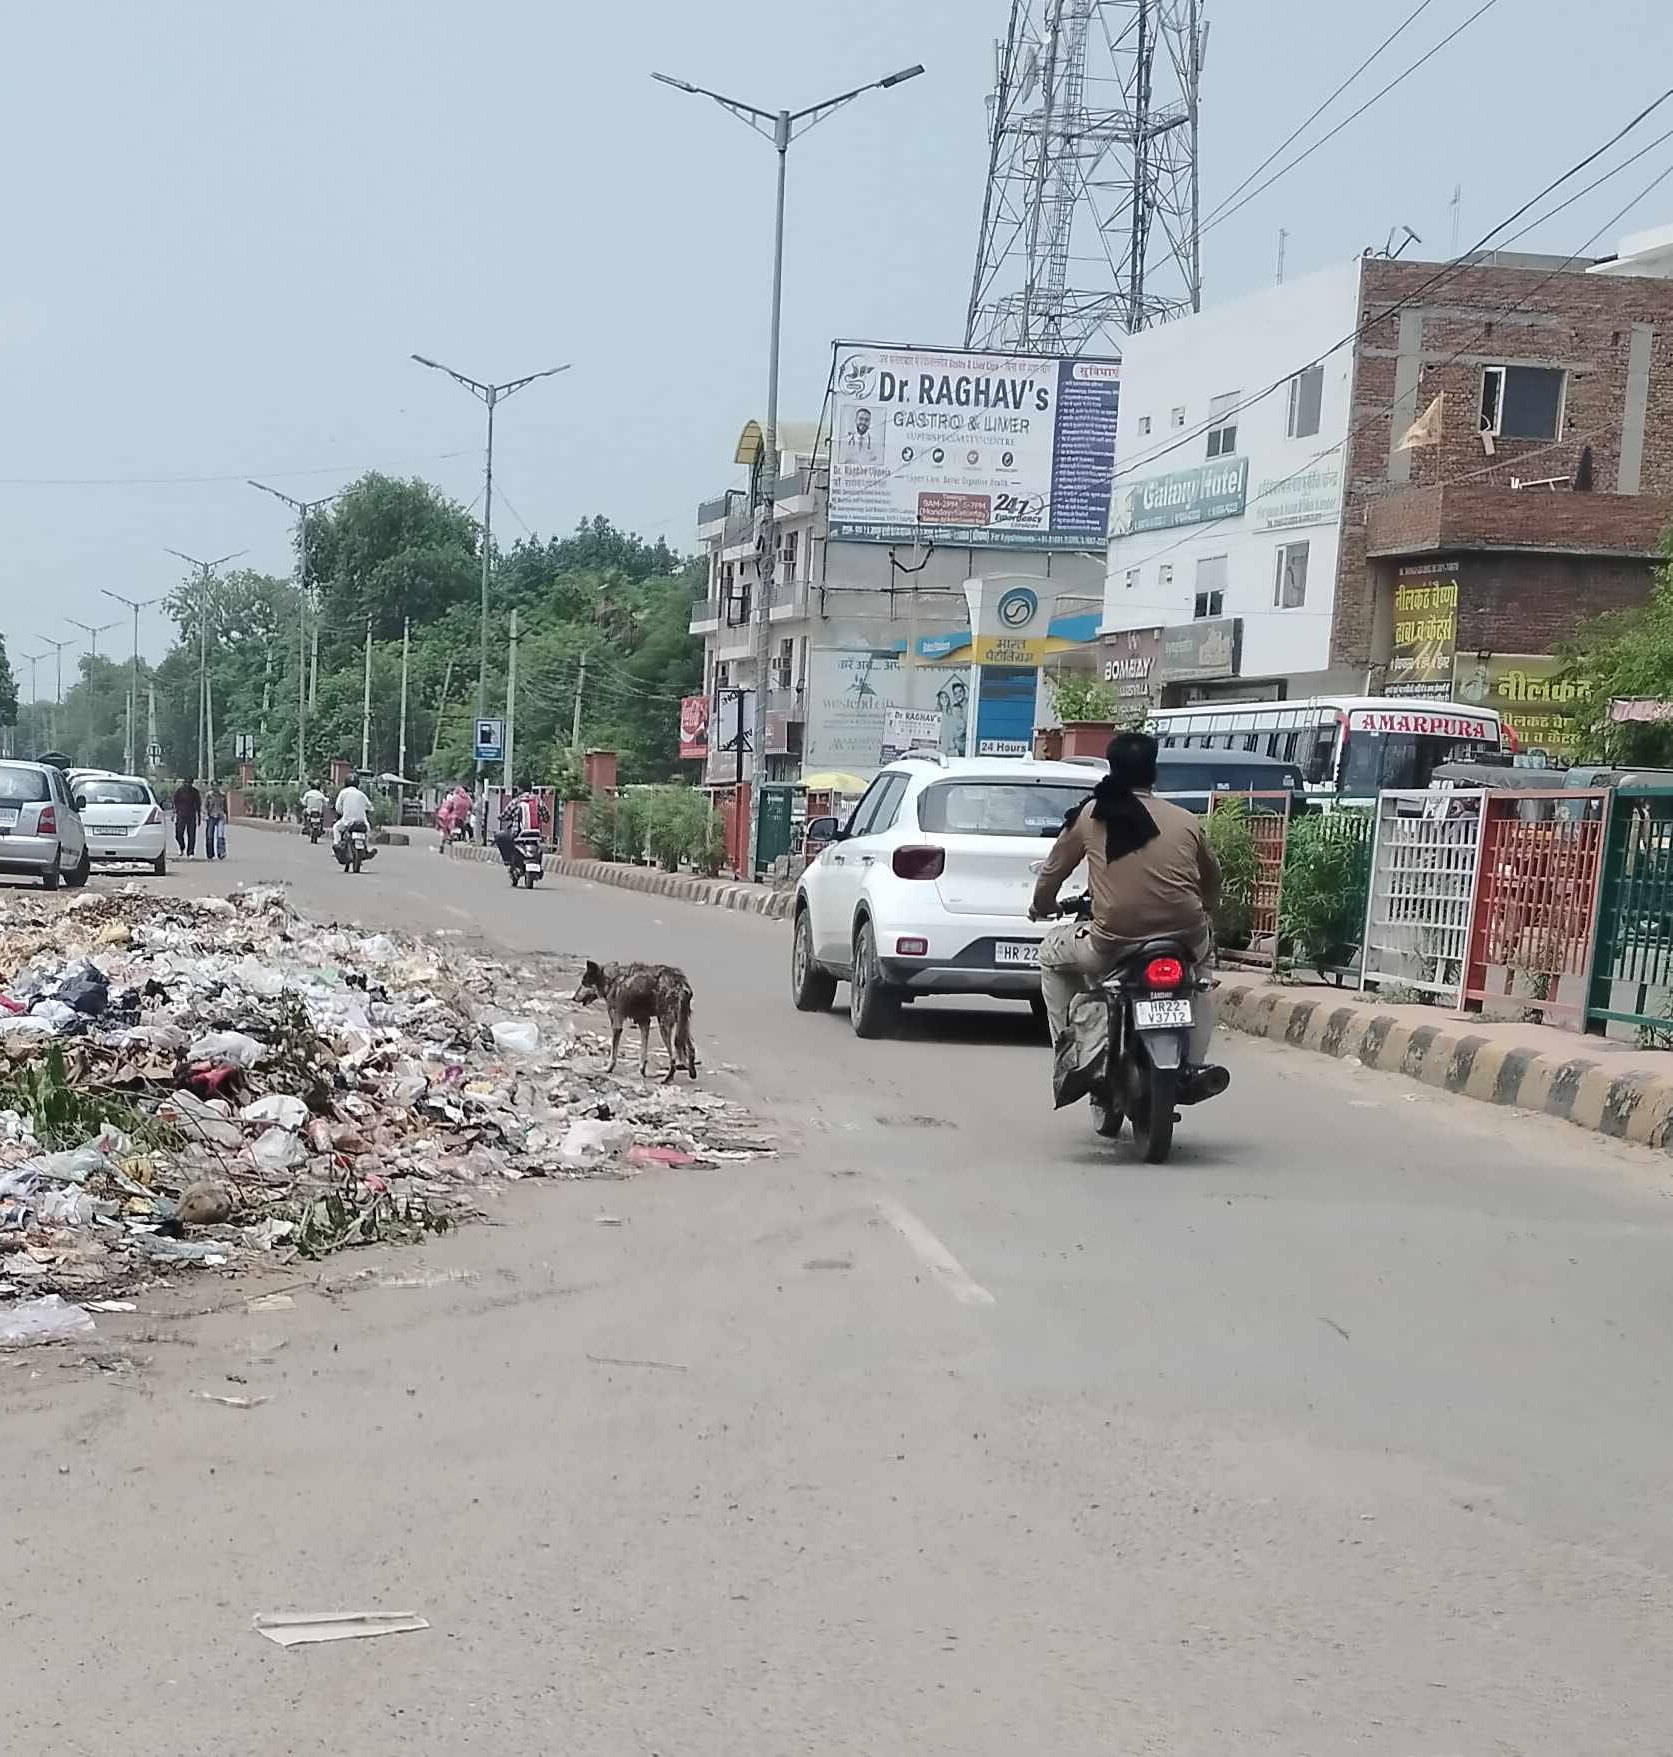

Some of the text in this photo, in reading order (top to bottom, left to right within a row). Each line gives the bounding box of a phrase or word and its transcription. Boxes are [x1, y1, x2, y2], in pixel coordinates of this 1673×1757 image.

[879, 371, 1050, 411] Dr. RAGHAV's
[893, 411, 1030, 434] GASTRO & LIVER
[1143, 476, 1198, 510] Galaxy
[1200, 462, 1244, 499] Hotel
[1362, 714, 1485, 737] AMARPURA
[981, 742, 1026, 752] 24 Hours
[1004, 946, 1019, 960] HR
[1150, 1001, 1180, 1012] HR22
[1148, 1012, 1186, 1023] V3712
